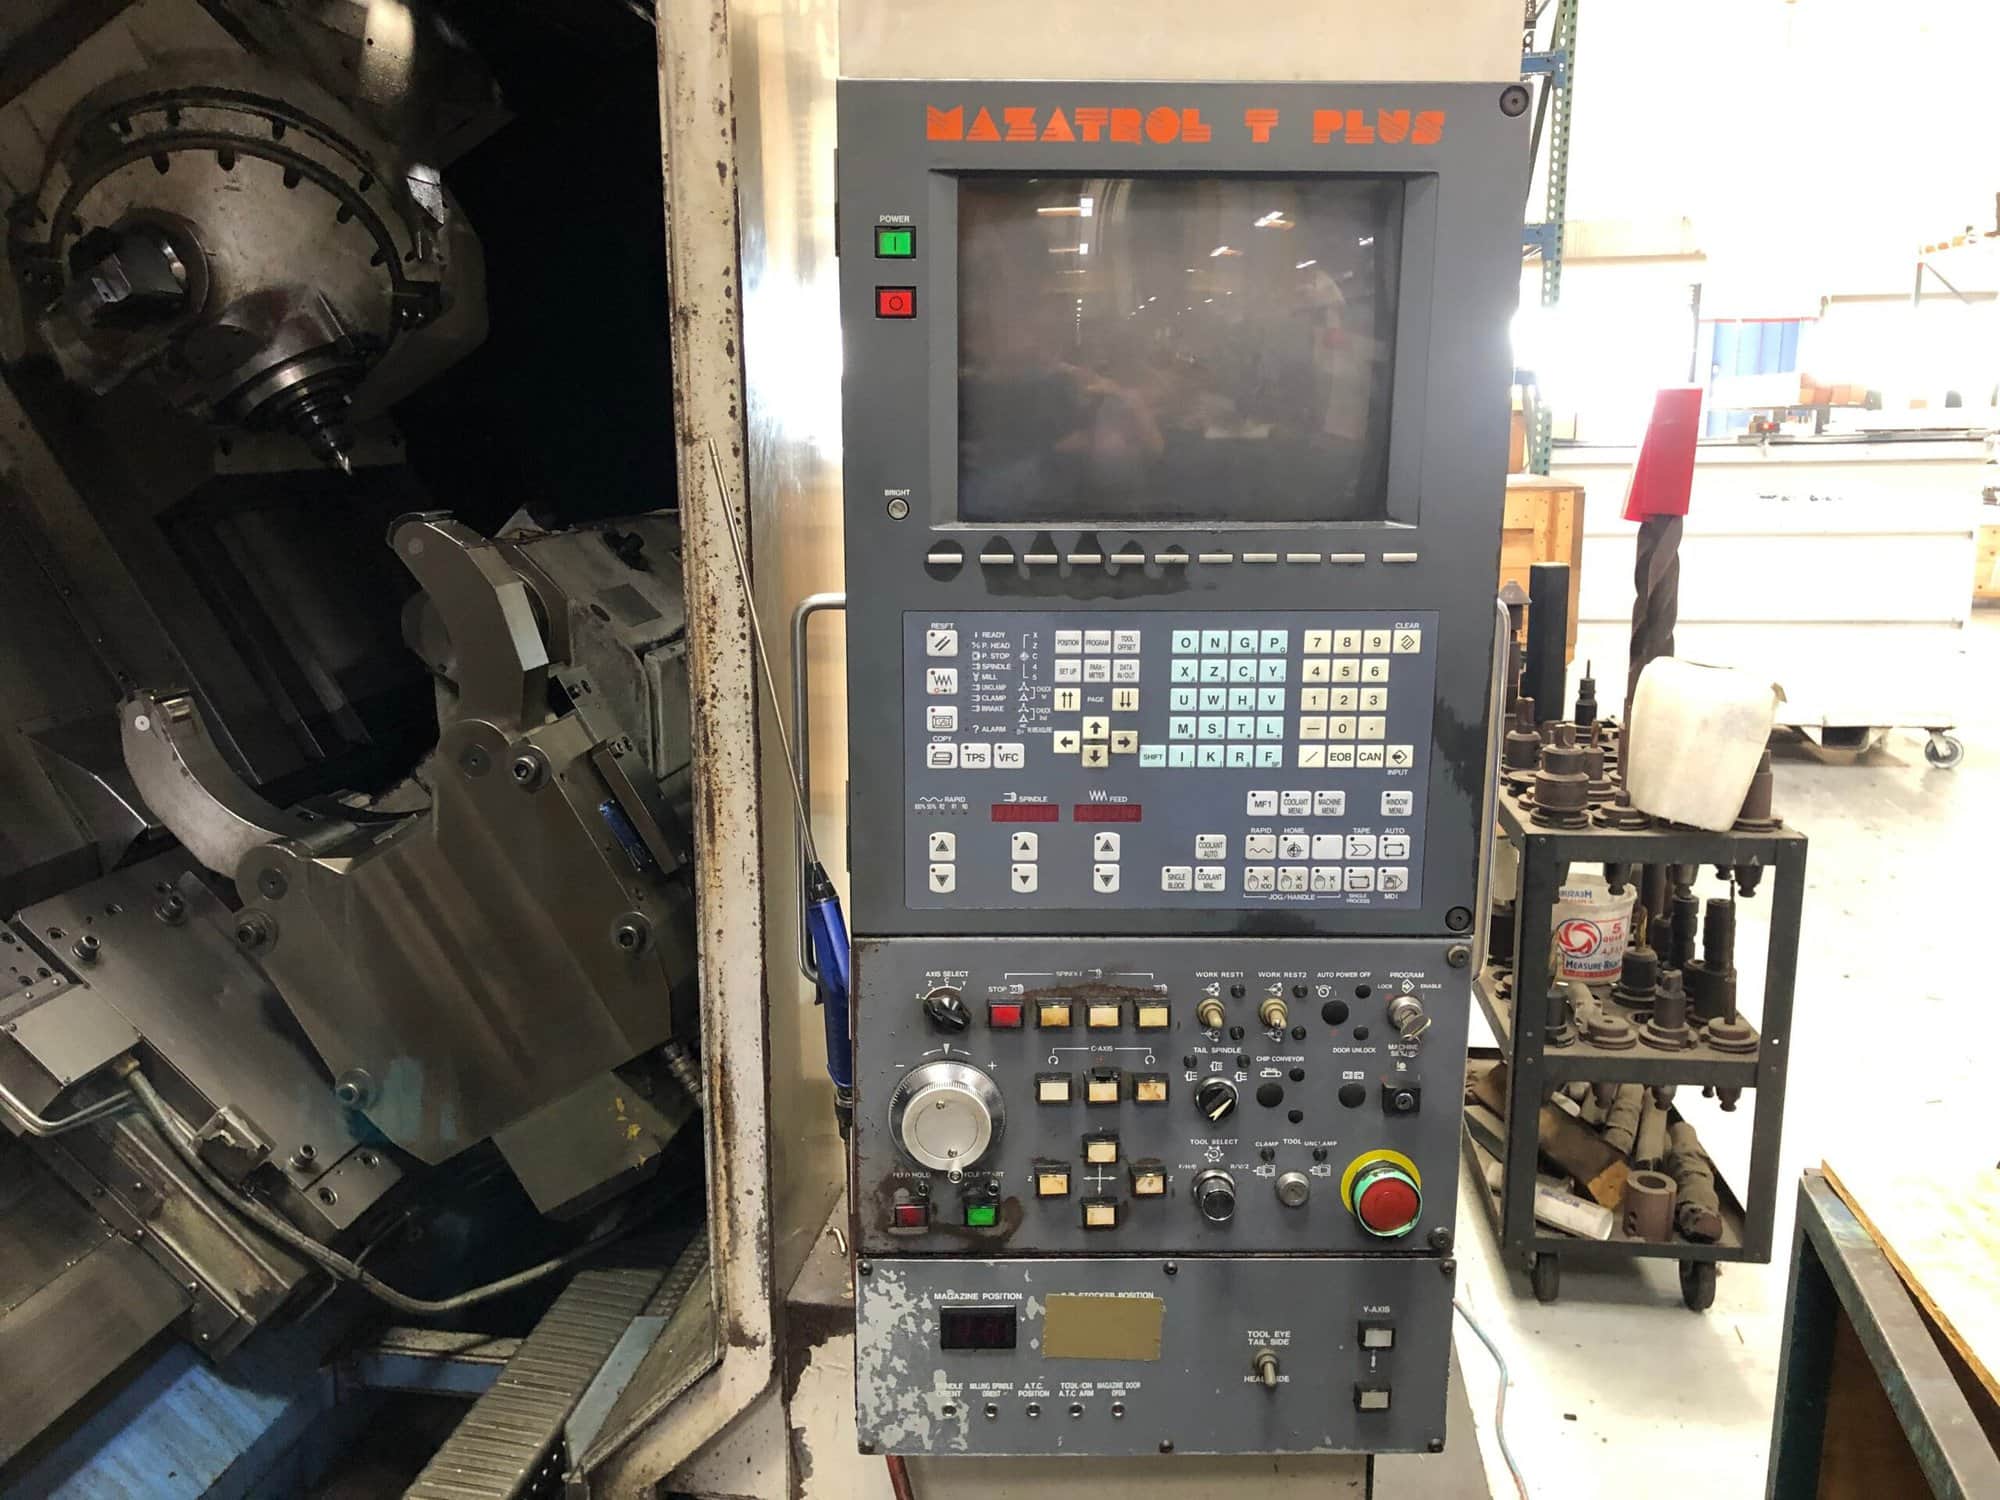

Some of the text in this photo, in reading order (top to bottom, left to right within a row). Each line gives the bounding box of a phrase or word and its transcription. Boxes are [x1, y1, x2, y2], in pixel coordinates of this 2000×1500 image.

[927, 104, 1446, 145] MAZATROL T PLUS
[879, 215, 910, 223] POWER
[1057, 639, 1080, 647] POSITION
[1085, 639, 1110, 647] PROGRAM
[1117, 643, 1137, 651] OFFSET
[1211, 638, 1220, 648] N
[1240, 637, 1250, 648] G
[1270, 638, 1279, 648] P
[1313, 637, 1322, 648] 7
[1343, 637, 1352, 647] 8
[1373, 637, 1382, 647] 9
[1181, 666, 1189, 677] X
[1210, 666, 1219, 677] Z
[1239, 666, 1248, 677] C
[1269, 666, 1277, 676] Y
[1312, 667, 1320, 676] 4
[1342, 666, 1350, 676] 5
[1371, 666, 1379, 676] 6
[1180, 695, 1188, 705] U
[1208, 695, 1219, 705] W
[1238, 695, 1247, 705] H
[1268, 695, 1276, 705] V
[1312, 695, 1317, 705] 1
[1341, 695, 1348, 705] 2
[1370, 695, 1378, 705] 3
[1178, 723, 1189, 734] M
[1208, 723, 1217, 734] S
[1238, 723, 1246, 734] T
[1267, 724, 1274, 734] L
[965, 753, 985, 763] TPS
[999, 753, 1019, 763] VFC
[1207, 751, 1215, 761] K
[1236, 751, 1245, 761] R
[1265, 751, 1273, 761] F
[1330, 752, 1352, 762] EOB
[1359, 752, 1382, 762] CAN
[1018, 795, 1048, 803] SPINDLE
[1109, 795, 1128, 803] FEED
[1317, 798, 1342, 806] MACHINE
[1386, 798, 1408, 806] WINDOW
[1287, 807, 1304, 815] MENU
[1321, 807, 1337, 815] MENU
[1388, 807, 1404, 815] MENU
[1203, 850, 1218, 858] AUTO
[1168, 873, 1185, 881] SINGLE
[1197, 873, 1222, 881] COOLANT
[1268, 893, 1316, 901] JOG/HANDLE
[1612, 921, 1622, 934] 5
[1211, 1046, 1242, 1054] SPINDLE
[934, 1292, 1023, 1300] MAGAZINE POSITION
[1248, 1338, 1290, 1346] TAIL SIDE
[1273, 1375, 1290, 1383] IDE
[969, 1382, 991, 1390] MILLING
[991, 1382, 1014, 1390] SPINDLE
[1018, 1390, 1050, 1398] POSITION
